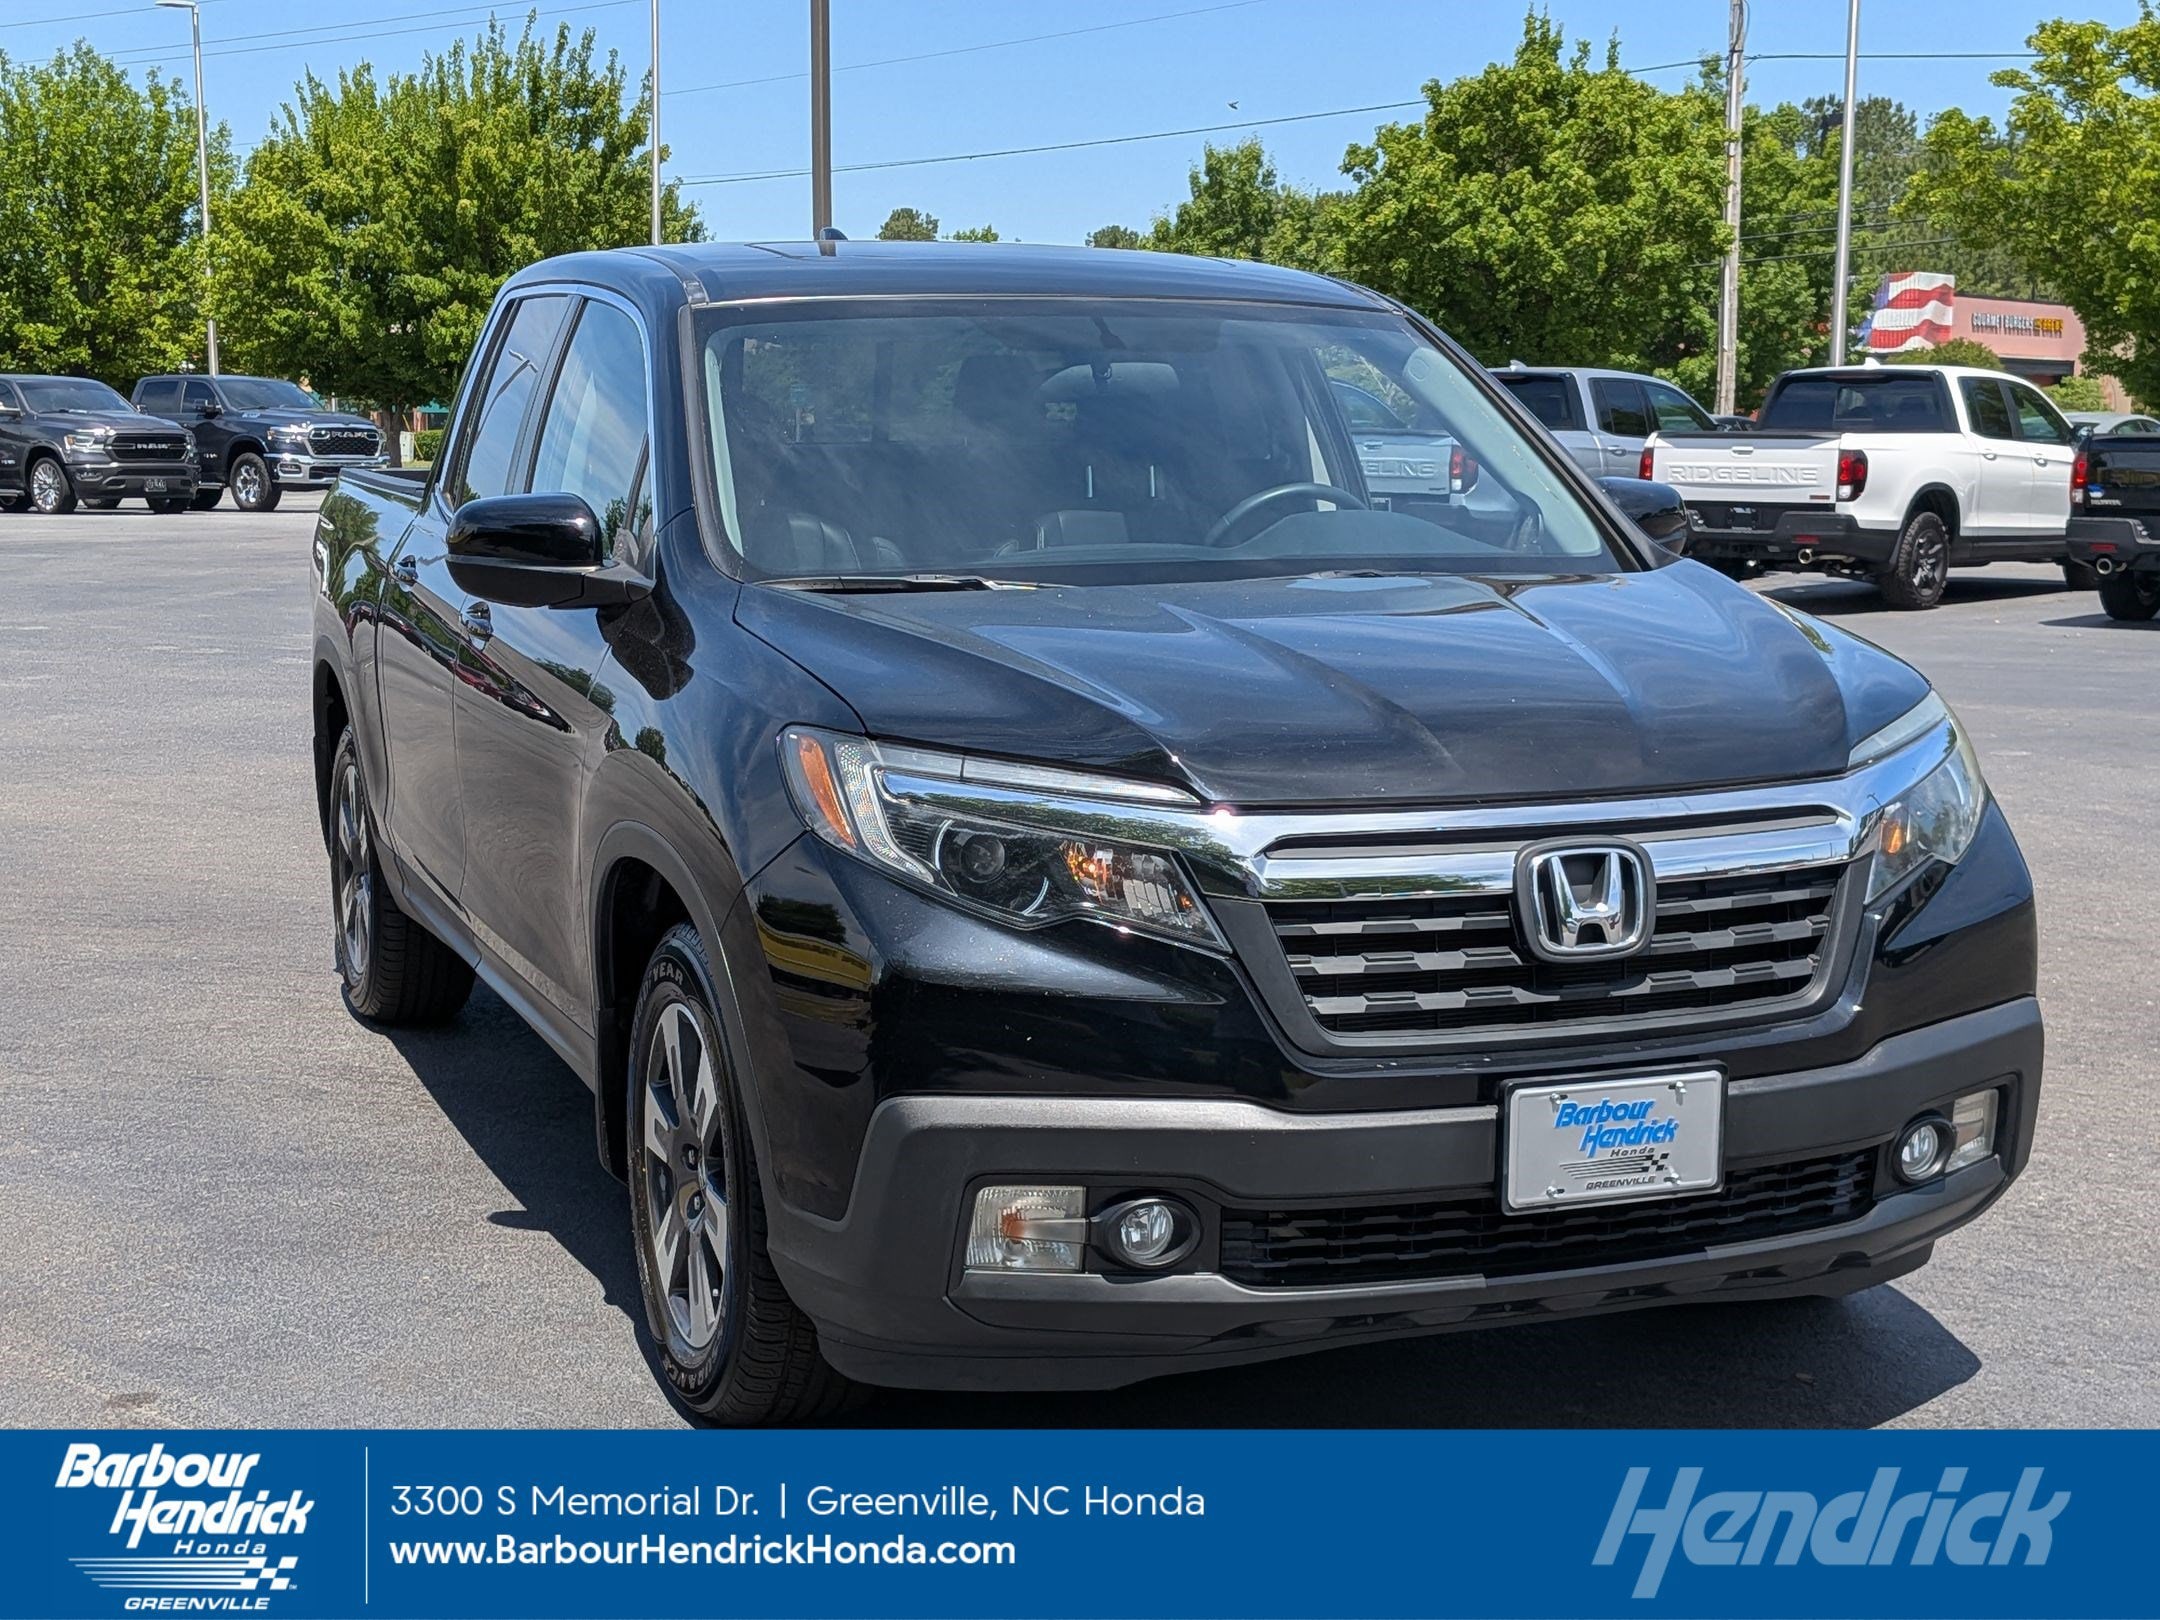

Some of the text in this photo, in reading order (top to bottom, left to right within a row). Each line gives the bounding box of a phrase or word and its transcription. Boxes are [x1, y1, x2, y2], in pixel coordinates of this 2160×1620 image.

[1668, 465, 1818, 484] RIDGELINE
[1556, 1099, 1655, 1128] Barbour
[1579, 1116, 1680, 1158] Hendrick
[1610, 1146, 1655, 1157] Honda
[1586, 1176, 1656, 1190] GREENVILLE
